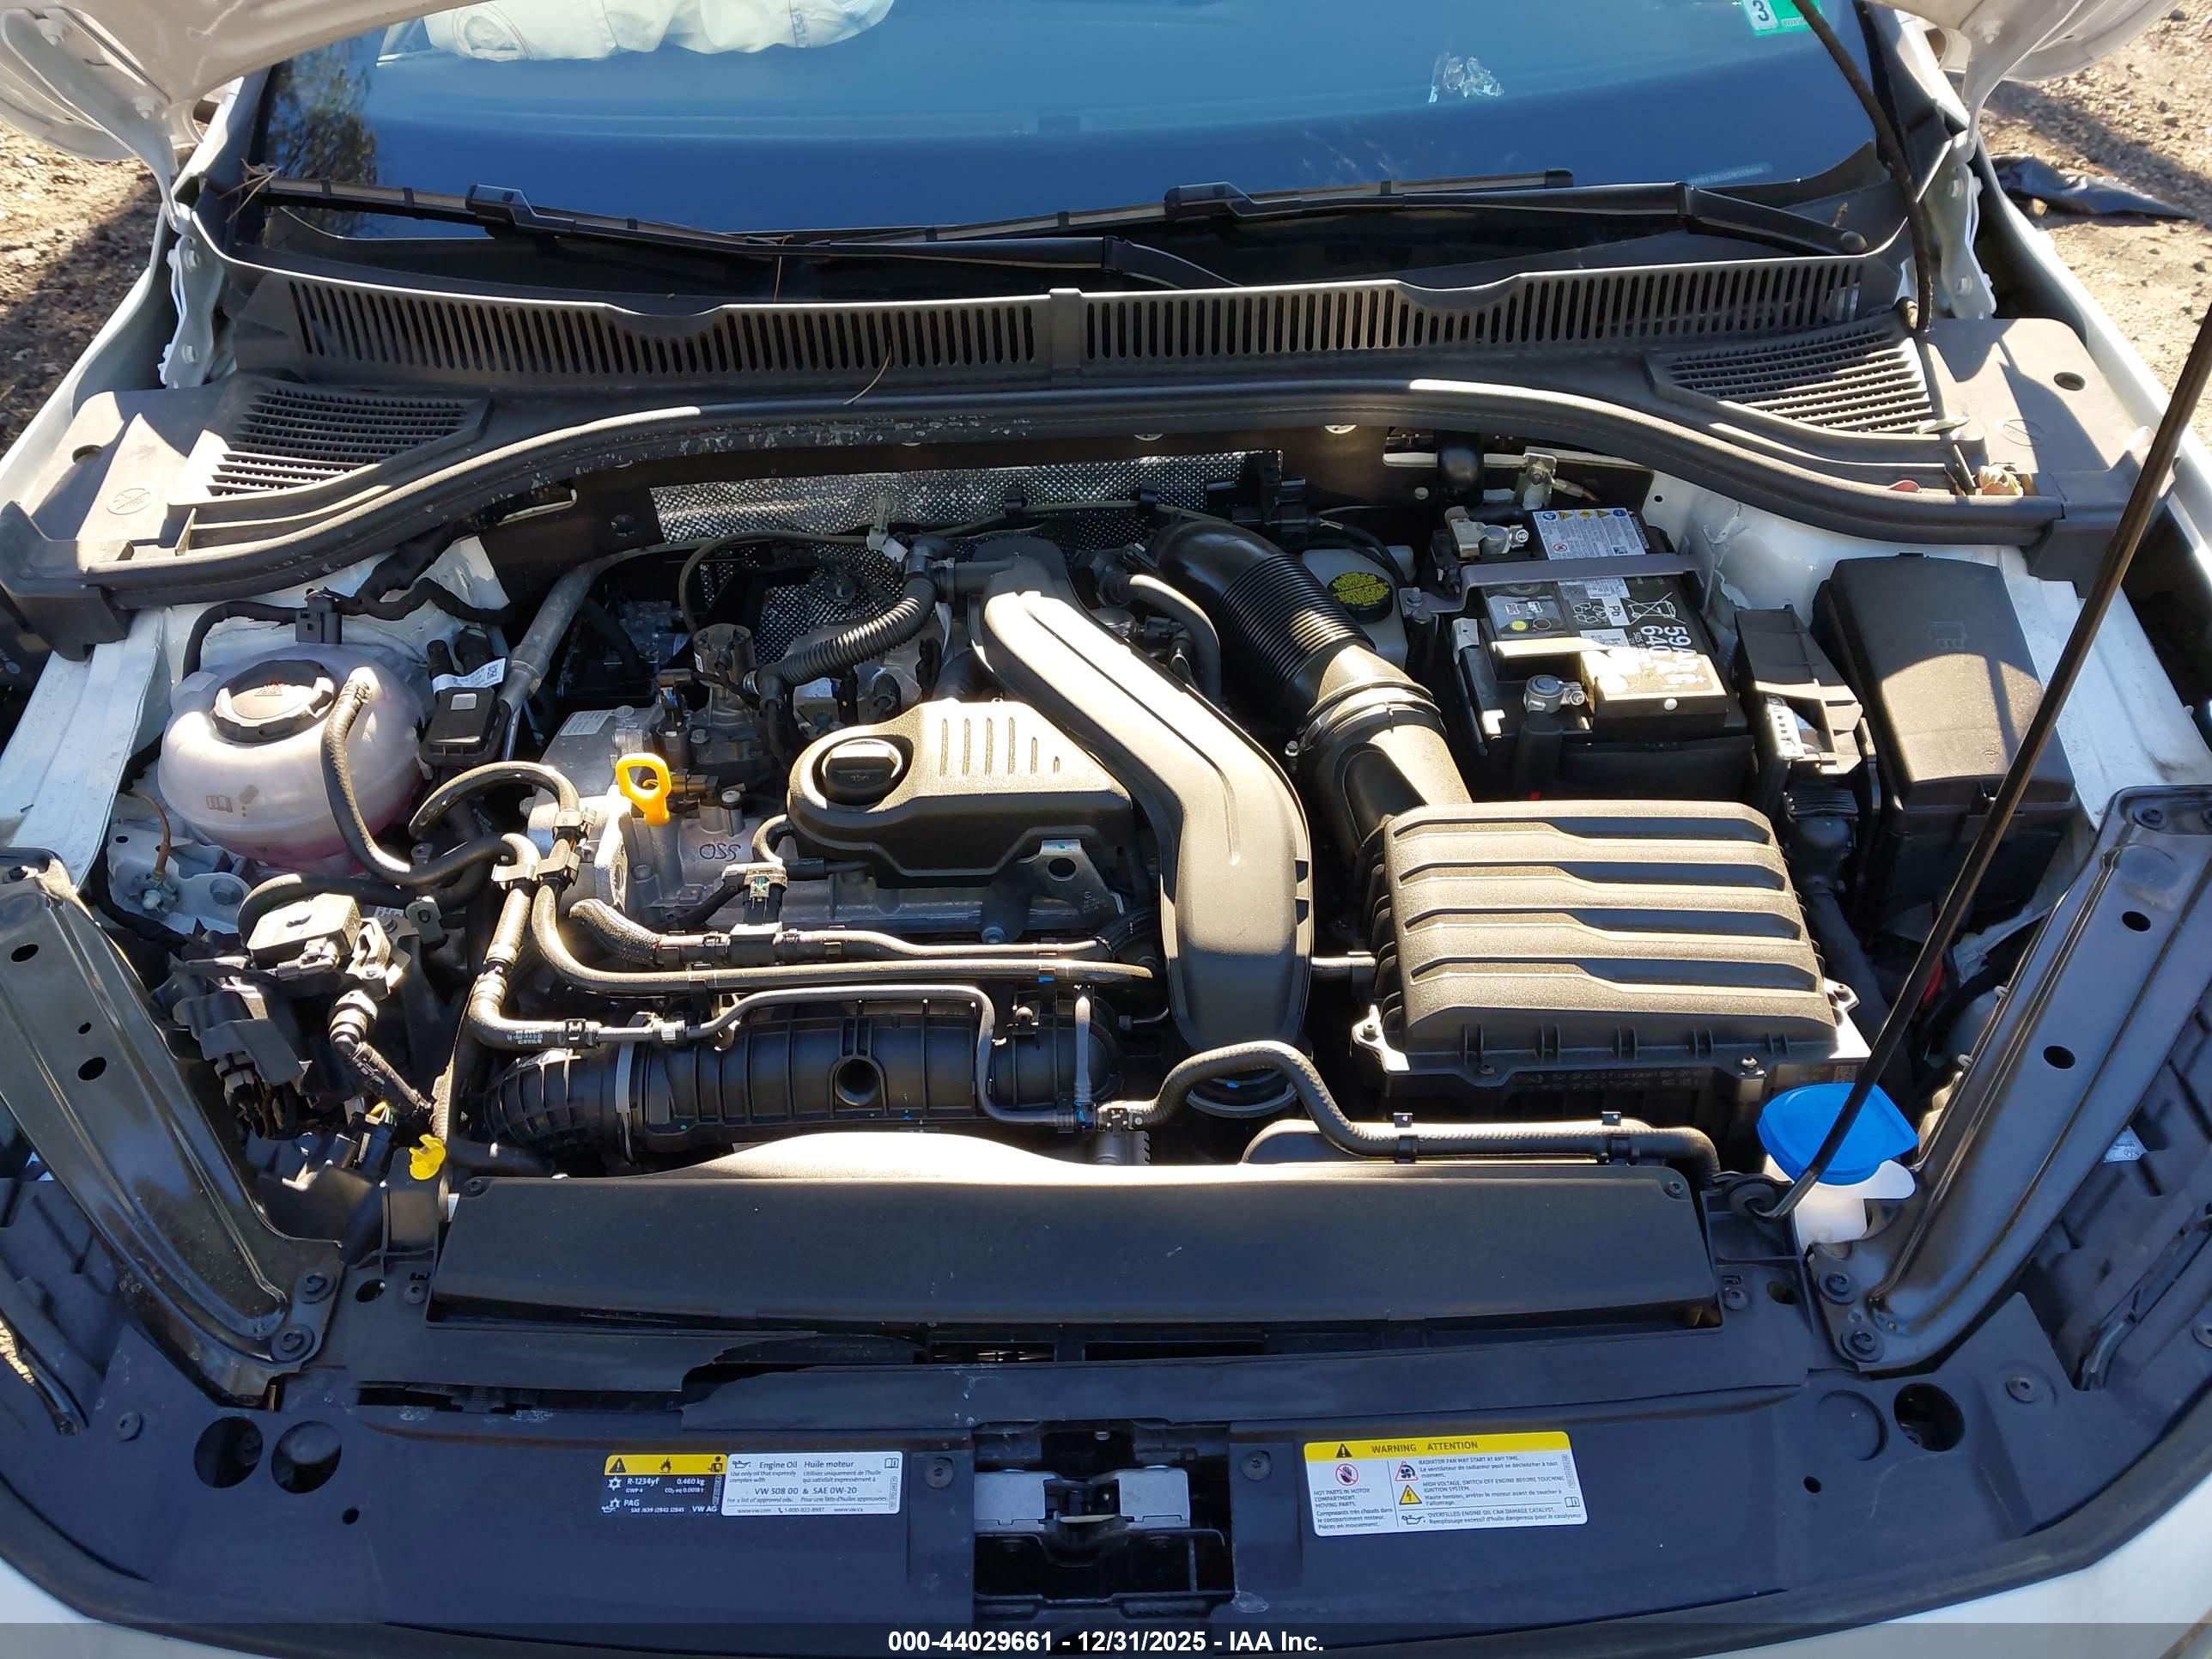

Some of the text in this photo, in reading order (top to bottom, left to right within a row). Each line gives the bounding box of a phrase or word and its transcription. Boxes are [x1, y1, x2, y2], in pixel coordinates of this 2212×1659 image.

[1752, 0, 1770, 21] 3
[1608, 605, 1622, 617] Pb
[1371, 1441, 1479, 1453] WARNING ATTENTION
[759, 1462, 785, 1470] Engine
[804, 1460, 824, 1468] Huile
[627, 1477, 659, 1486] R-1234yf
[696, 1478, 705, 1486] kg
